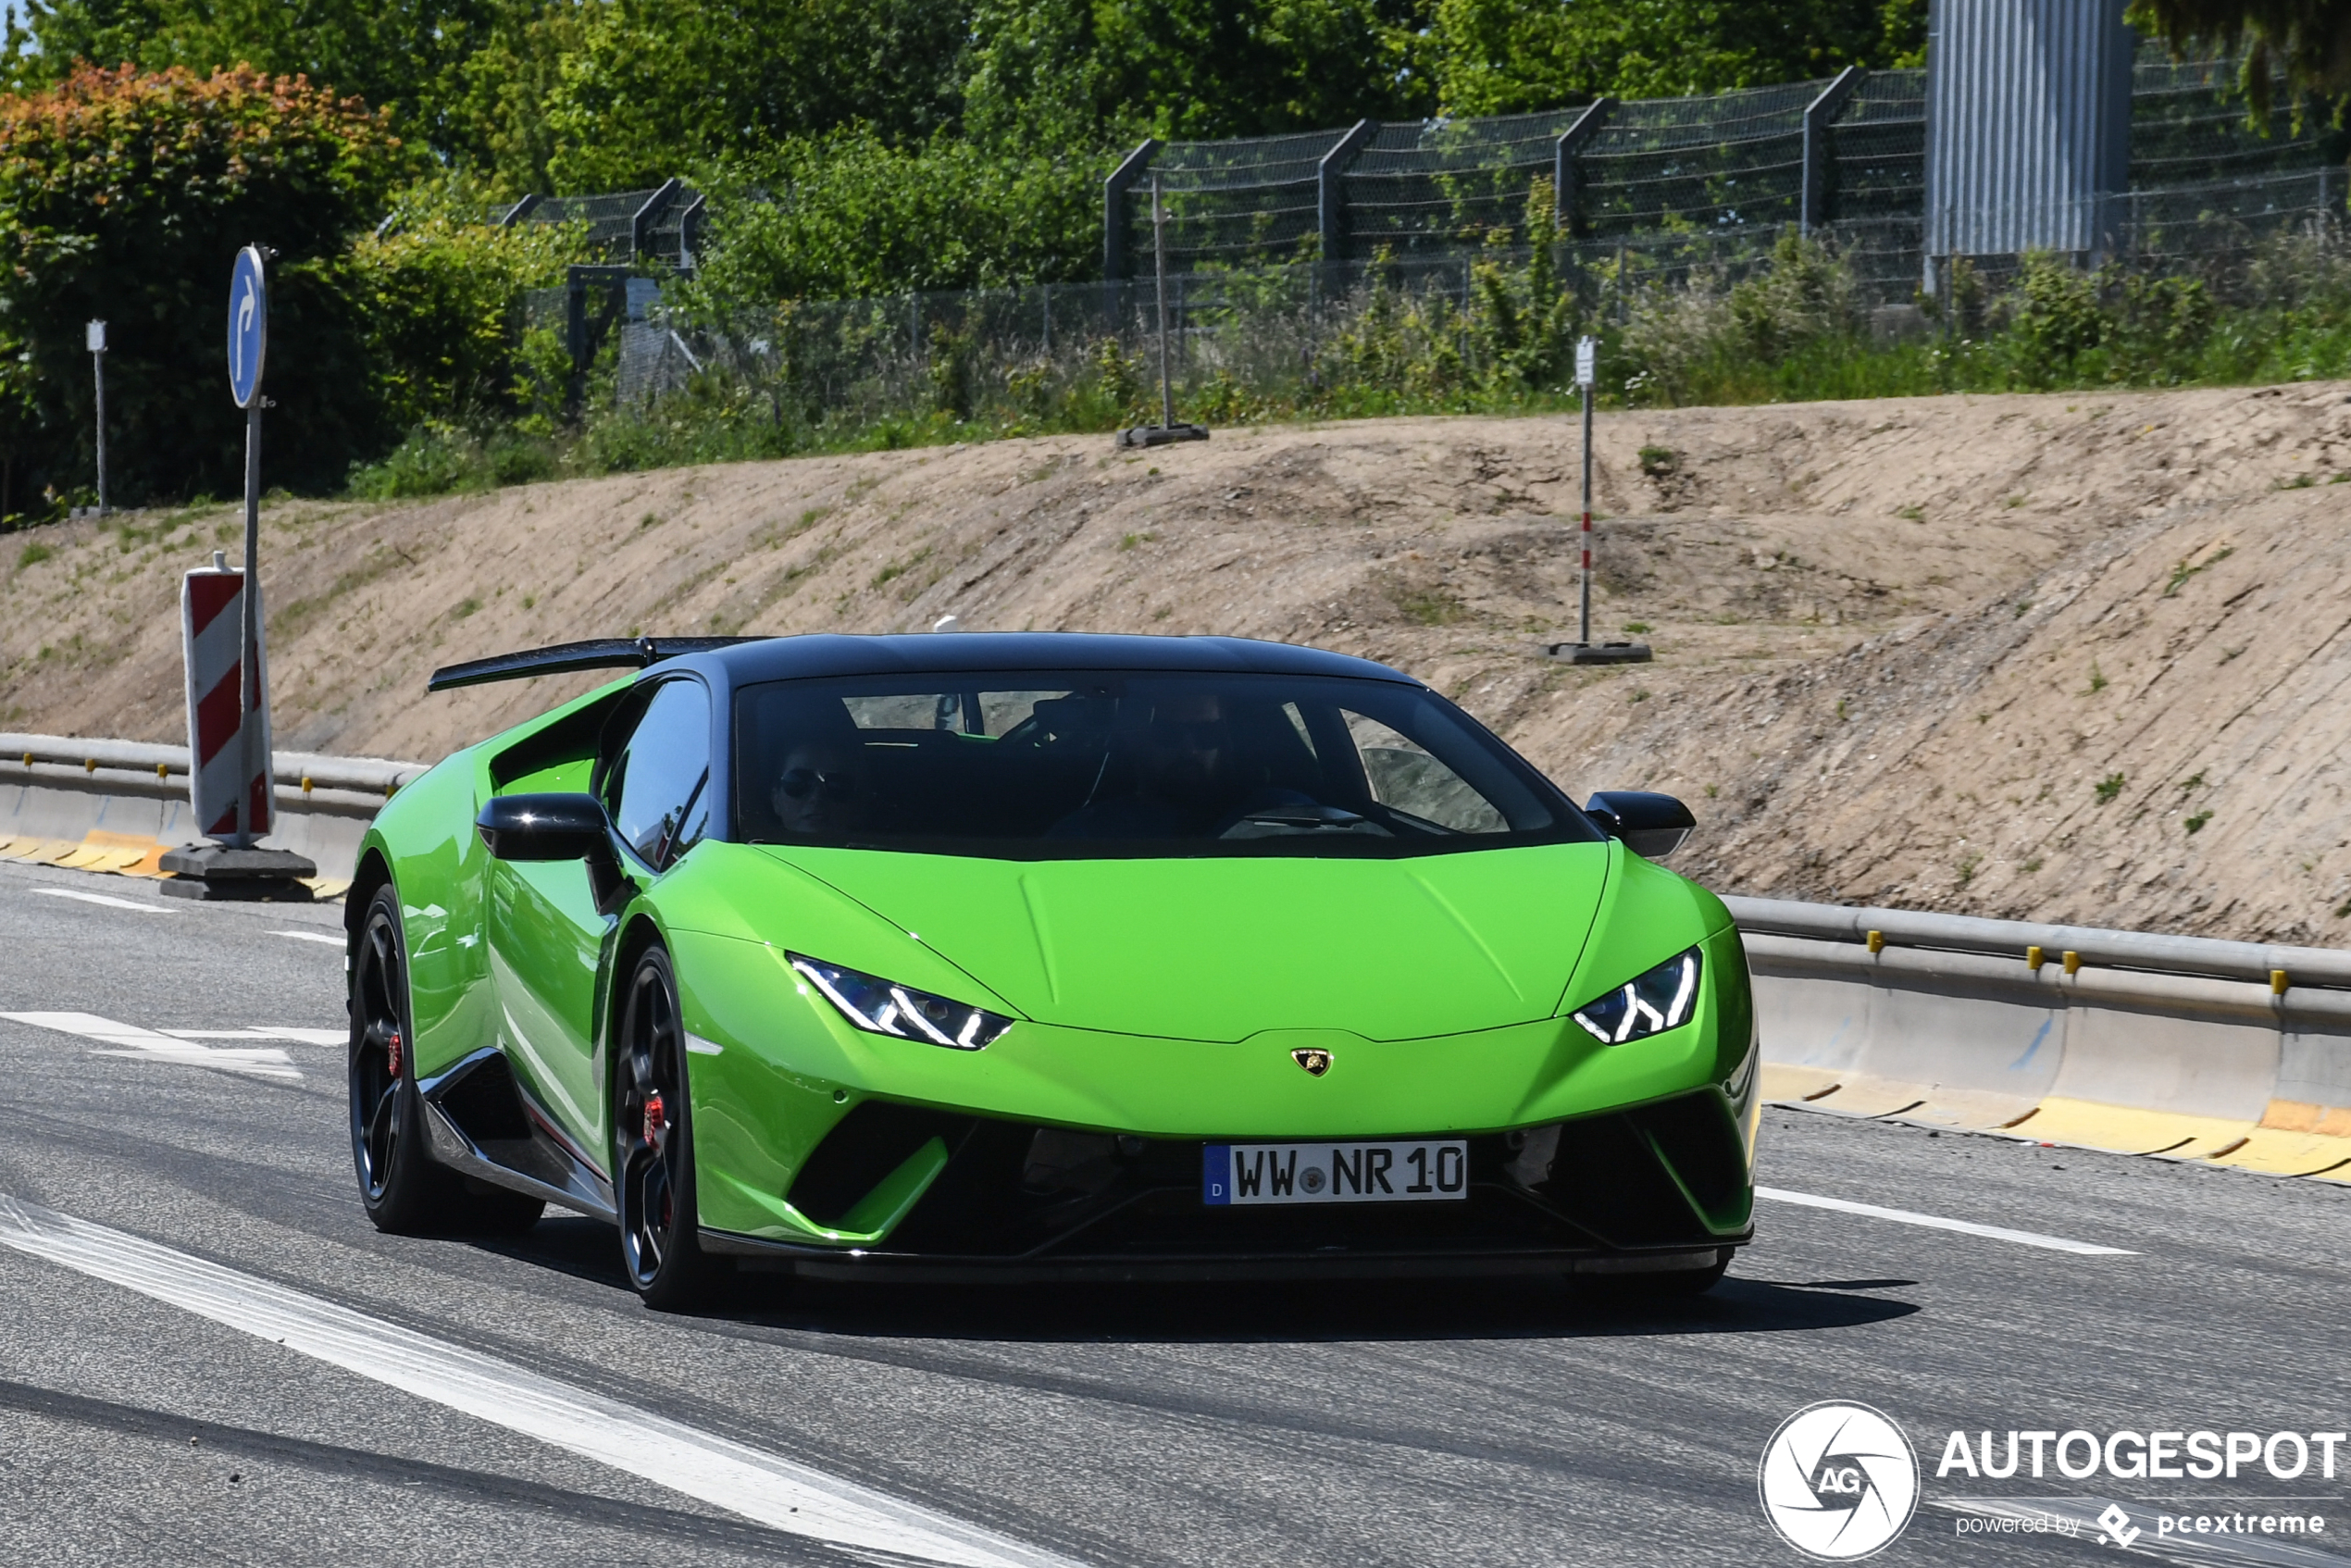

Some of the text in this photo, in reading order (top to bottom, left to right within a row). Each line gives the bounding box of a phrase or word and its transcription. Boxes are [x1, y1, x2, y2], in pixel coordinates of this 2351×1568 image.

[1235, 1146, 1465, 1198] WW NR 10
[1211, 1183, 1223, 1198] D
